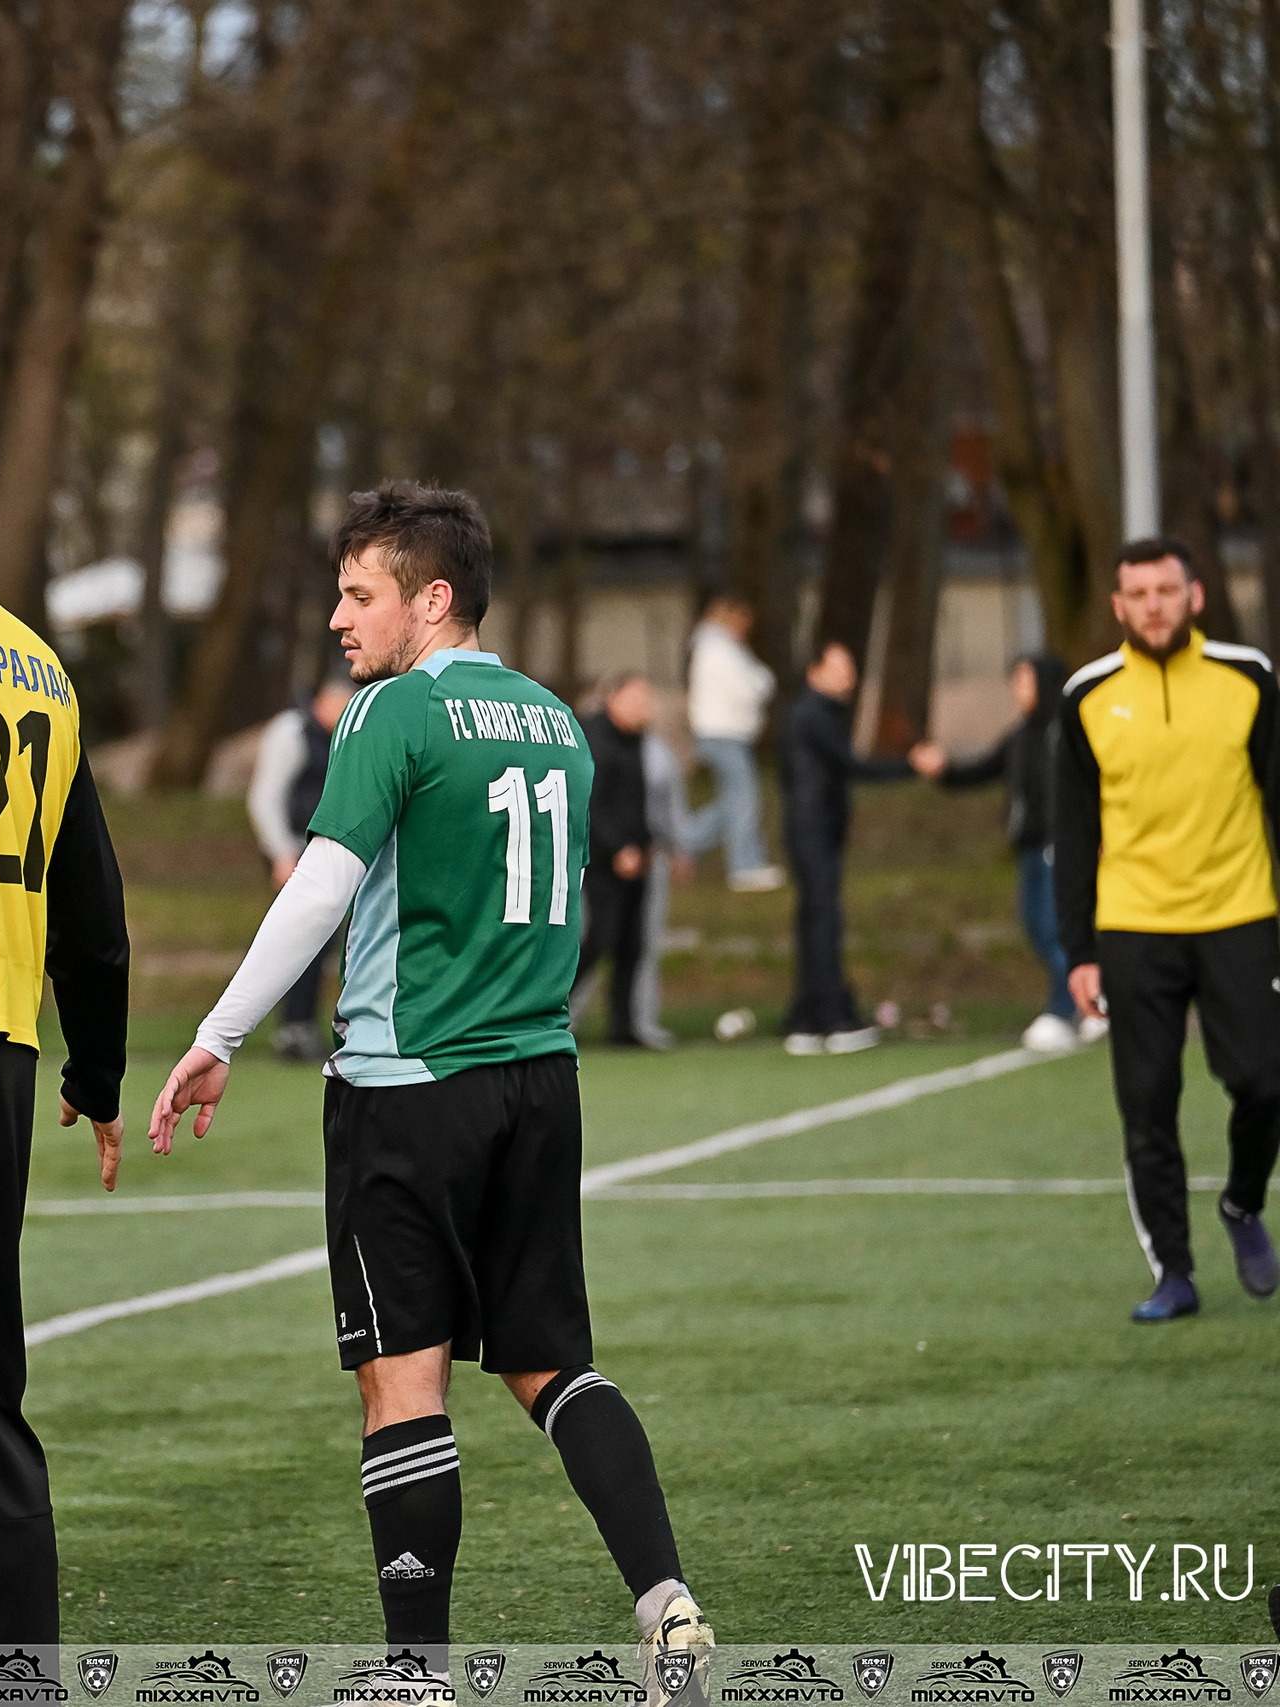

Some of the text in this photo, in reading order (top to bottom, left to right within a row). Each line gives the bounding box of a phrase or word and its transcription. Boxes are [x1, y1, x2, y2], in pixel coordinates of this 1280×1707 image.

[444, 699, 473, 741] FC
[488, 766, 569, 925] 11
[380, 1567, 435, 1579] adidas
